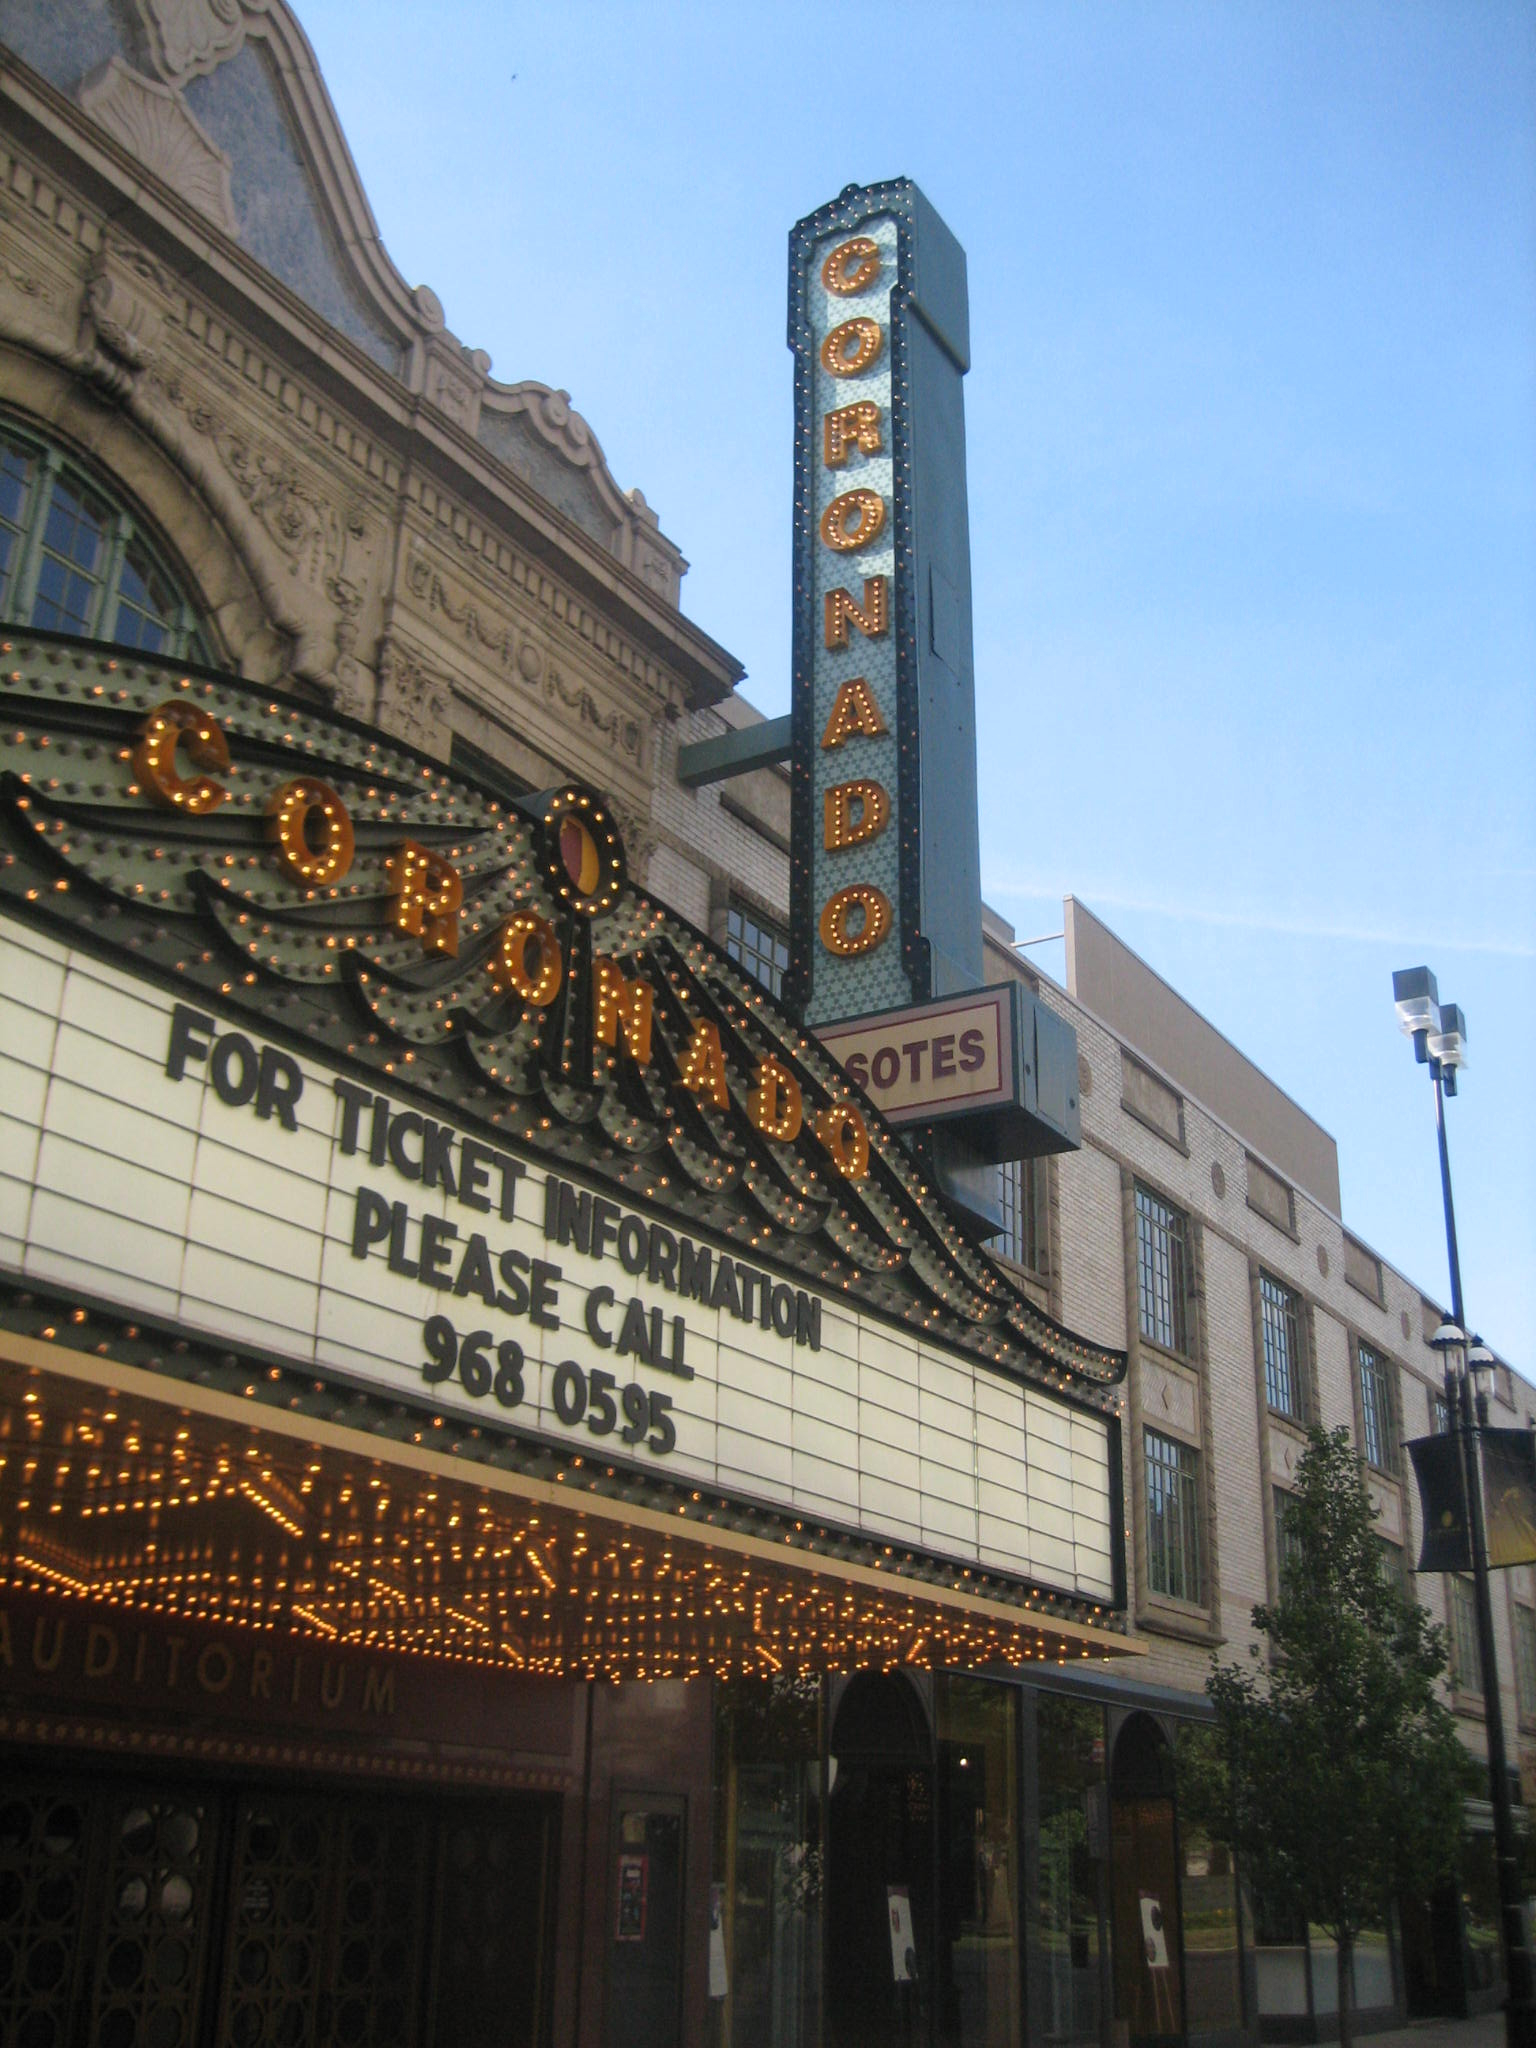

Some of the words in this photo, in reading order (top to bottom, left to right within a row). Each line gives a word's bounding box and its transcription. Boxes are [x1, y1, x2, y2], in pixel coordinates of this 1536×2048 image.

[819, 237, 892, 957] CORONADO
[131, 699, 871, 1180] CORONADO
[166, 1003, 303, 1131] FOR
[334, 1077, 526, 1222] TICKET
[545, 1174, 821, 1351] INFORMATION
[351, 1186, 562, 1330] PLEASE
[586, 1286, 694, 1380] CALL
[422, 1315, 524, 1406] 968
[552, 1360, 676, 1454] 0595
